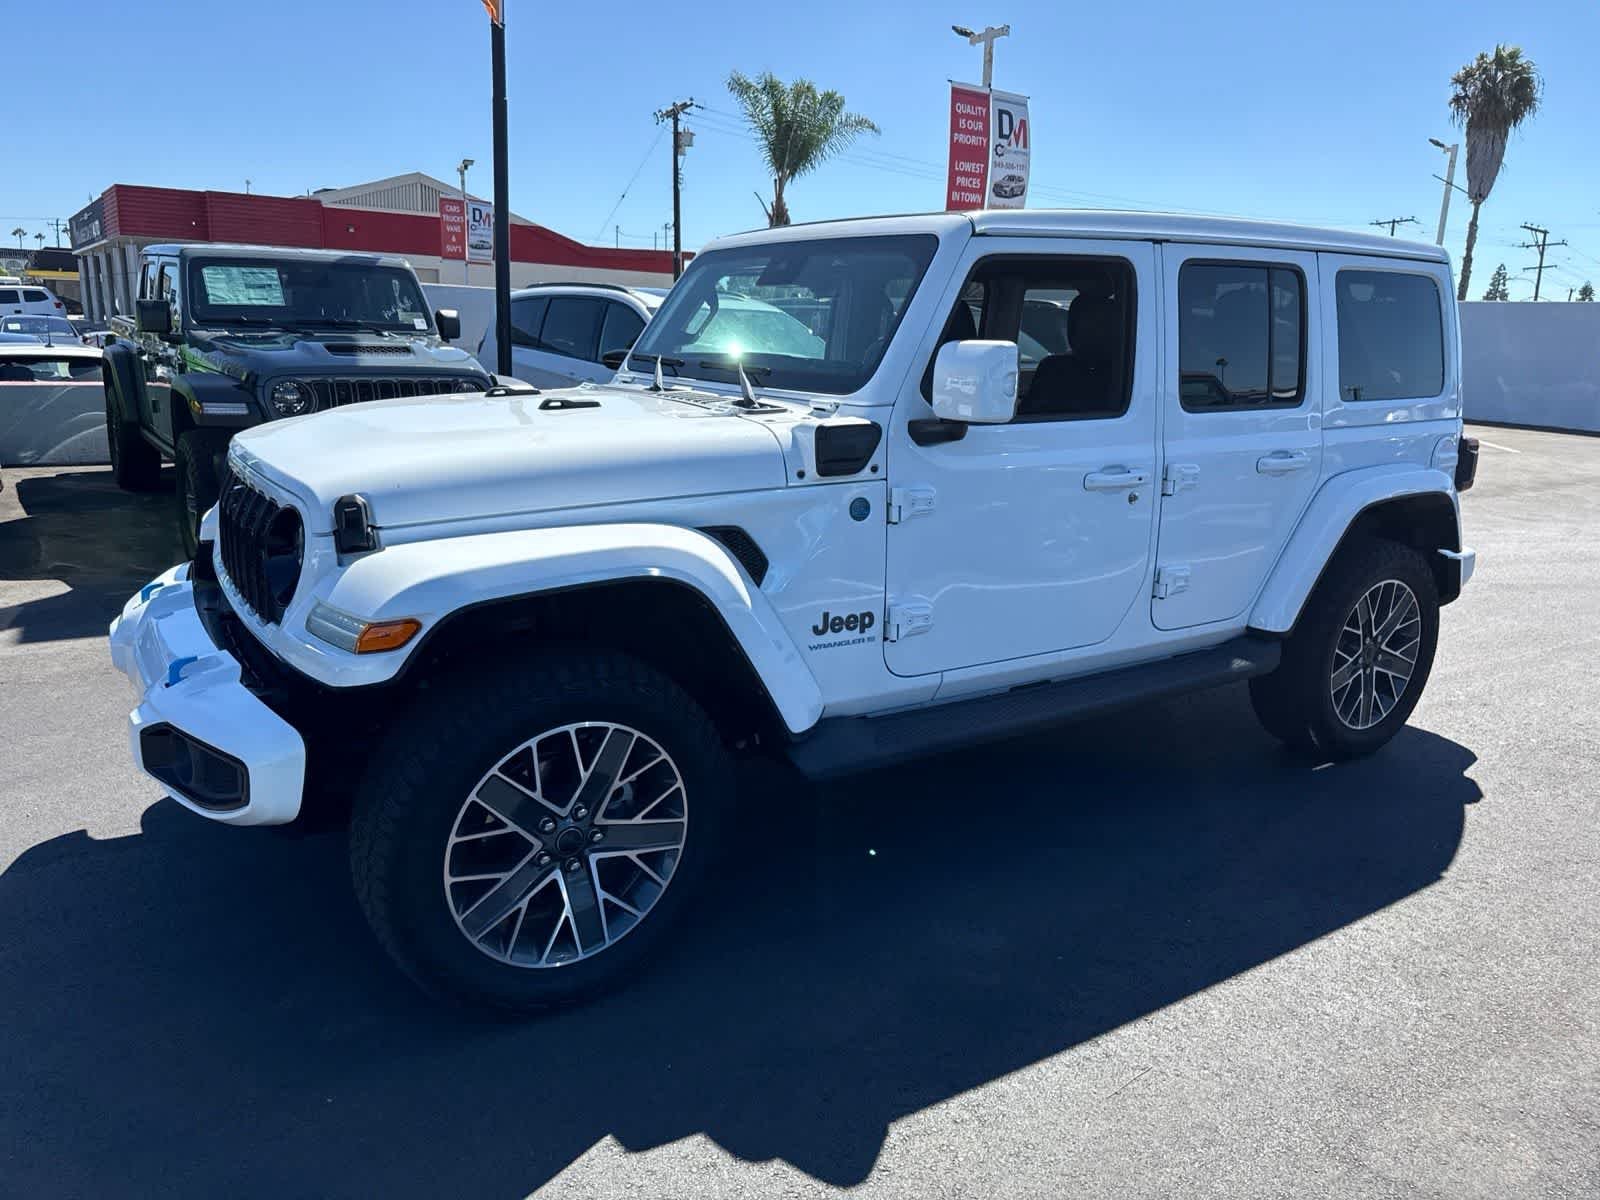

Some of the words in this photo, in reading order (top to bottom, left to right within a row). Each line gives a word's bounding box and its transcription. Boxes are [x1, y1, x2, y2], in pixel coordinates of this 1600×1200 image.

[955, 103, 987, 117] QUALITY
[959, 119, 966, 129] IS
[967, 120, 983, 132] OUR
[953, 133, 988, 147] PRIORITY
[955, 160, 984, 174] LOWEST
[956, 177, 981, 189] PRICES
[951, 191, 960, 201] IN
[960, 193, 983, 204] TOWN
[812, 611, 875, 636] Jeep
[808, 638, 865, 651] WRANGLER
